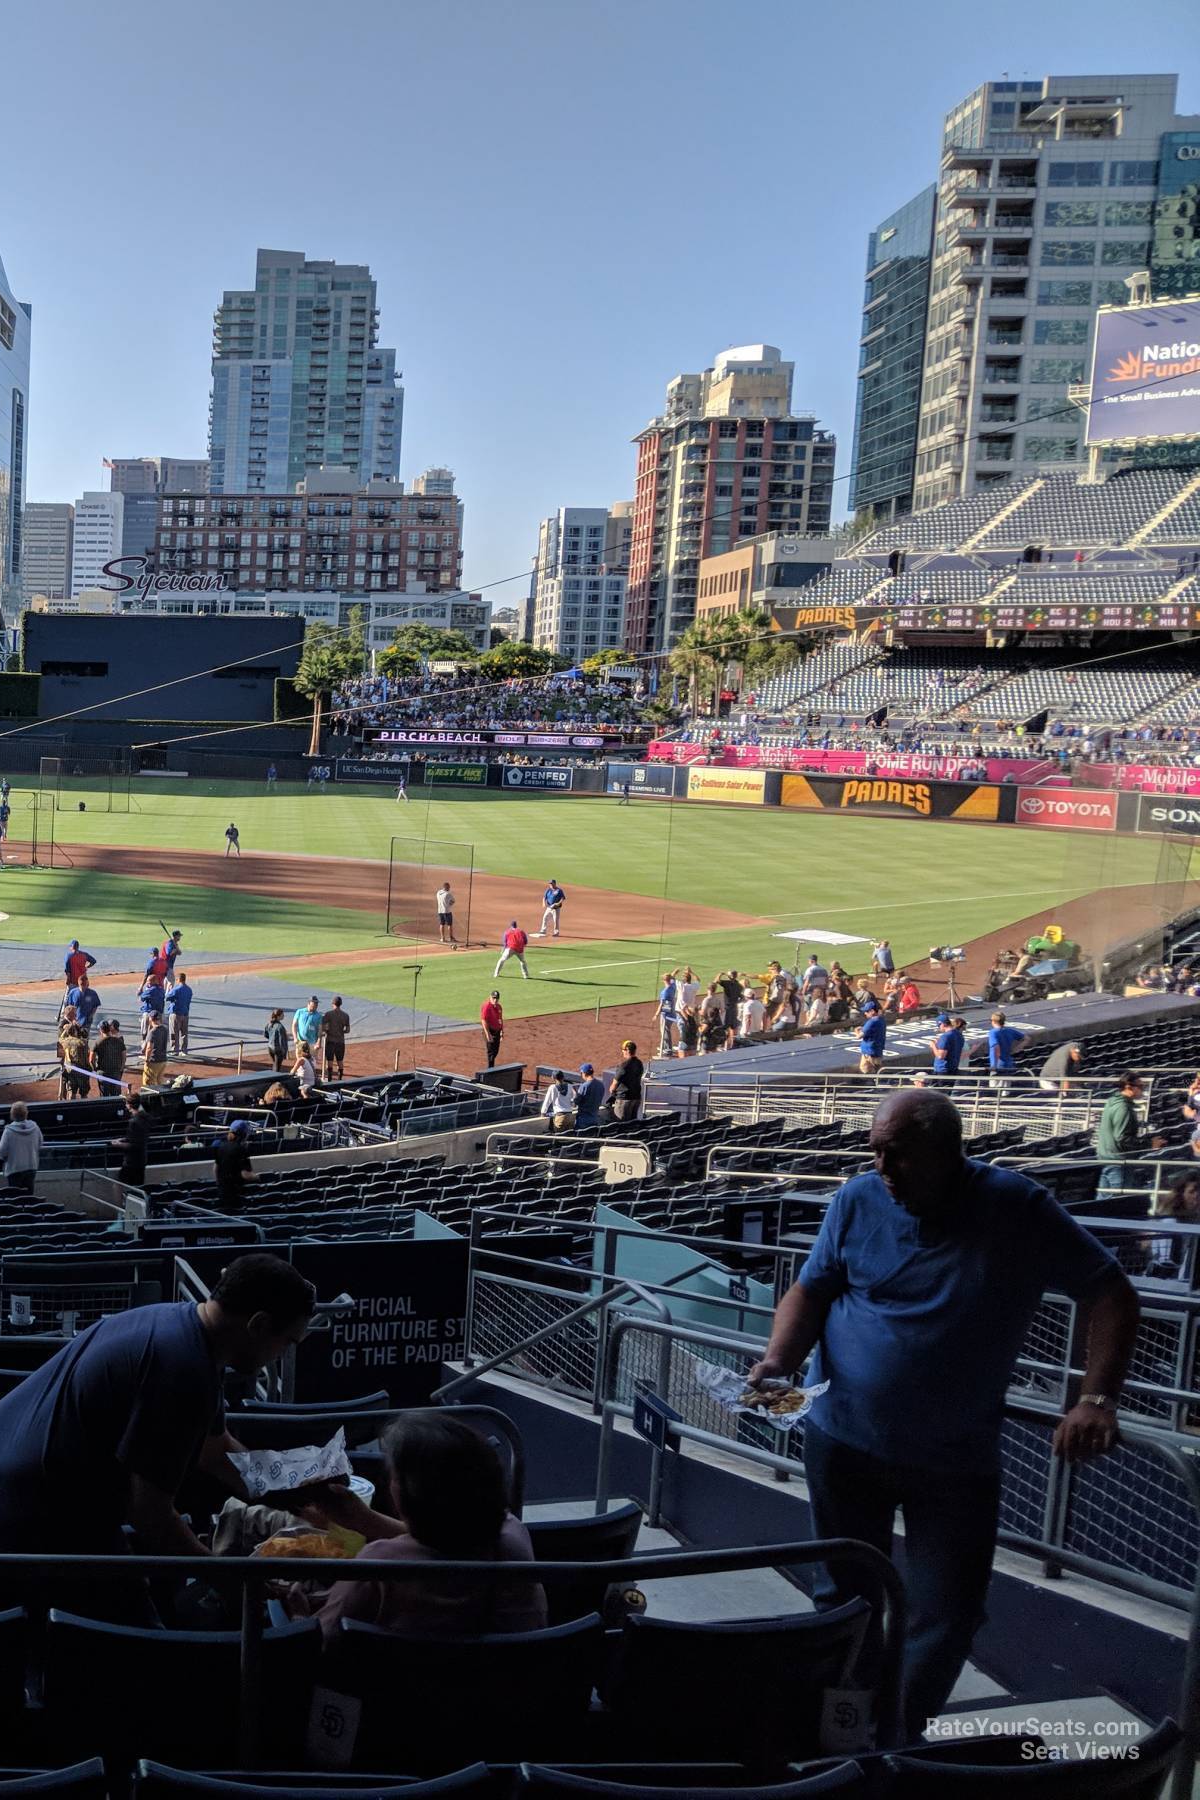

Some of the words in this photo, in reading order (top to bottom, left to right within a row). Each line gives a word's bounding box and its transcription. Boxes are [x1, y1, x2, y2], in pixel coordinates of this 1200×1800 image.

[1120, 393, 1142, 402] Small
[1144, 390, 1179, 400] Business
[100, 555, 229, 602] Sycuan
[795, 607, 856, 630] PADRES
[380, 731, 429, 741] PIRCH
[439, 733, 481, 743] BEACH
[365, 766, 382, 776] Diego
[865, 753, 909, 770] HOME
[912, 755, 945, 772] RUN
[946, 757, 988, 773] DECK
[524, 770, 567, 781] PENFED
[743, 781, 763, 791] Power
[841, 780, 934, 816] PADRES
[1046, 800, 1112, 817] TOYOTA
[612, 1161, 633, 1176] 103
[732, 1285, 747, 1300] 103
[333, 1319, 437, 1343] FURNITURE
[332, 1349, 356, 1368] OF
[363, 1346, 397, 1366] THE
[644, 1412, 653, 1429] H
